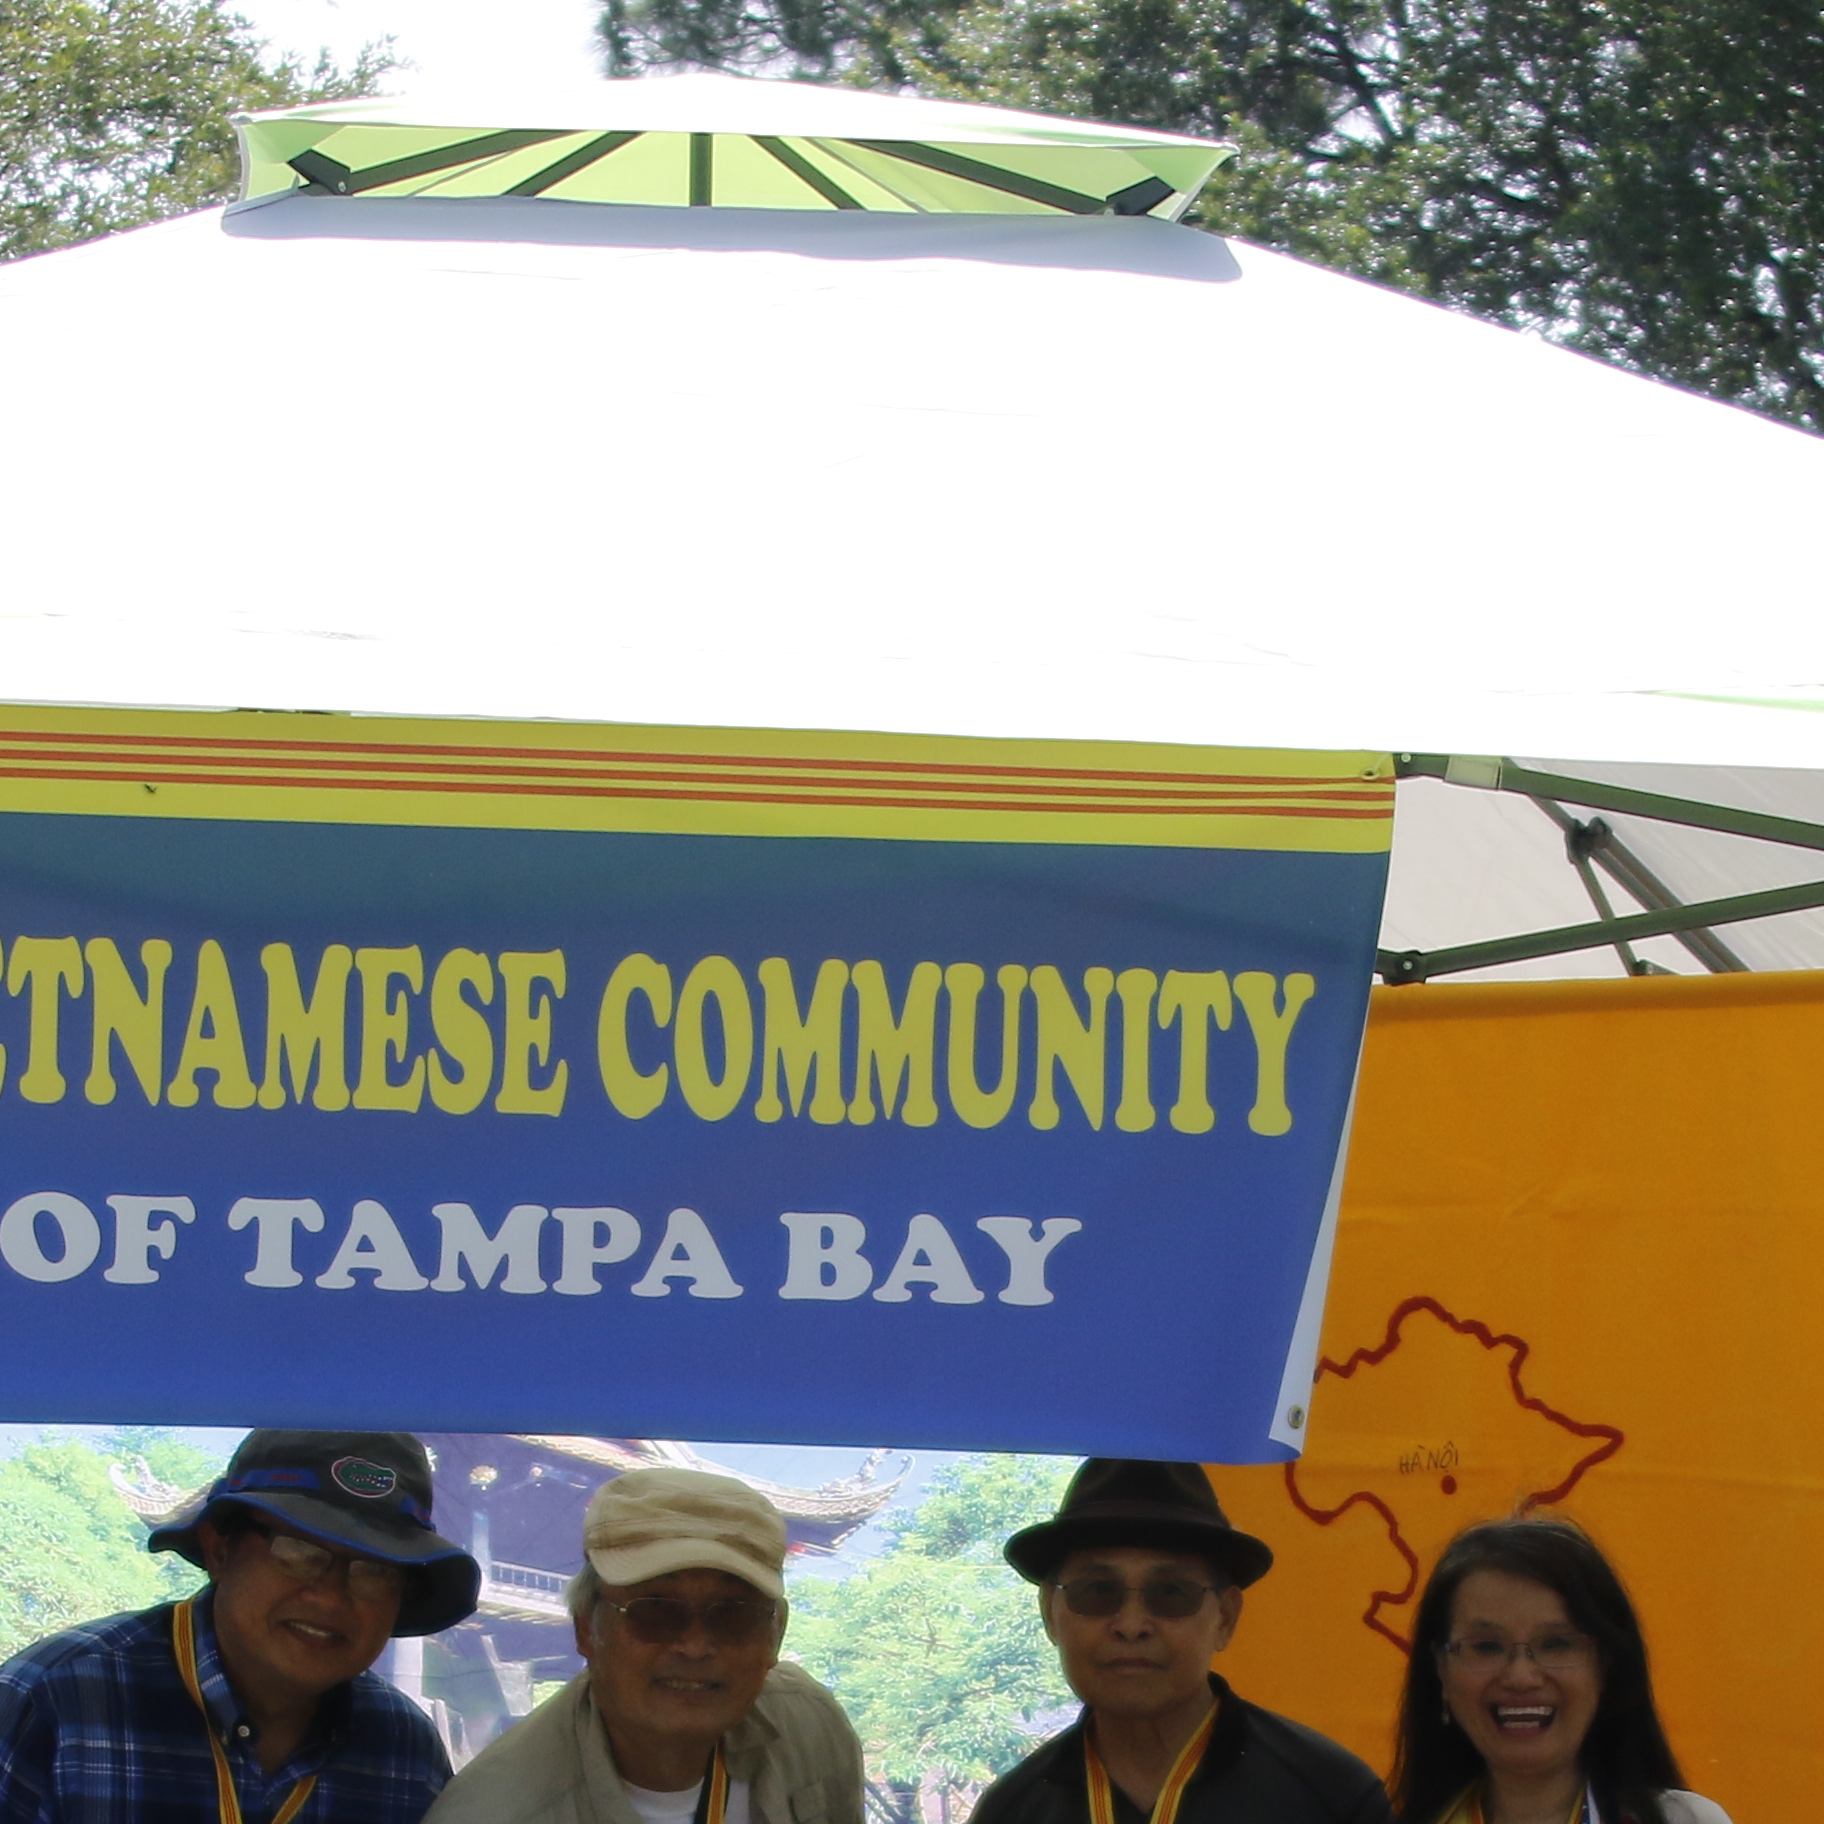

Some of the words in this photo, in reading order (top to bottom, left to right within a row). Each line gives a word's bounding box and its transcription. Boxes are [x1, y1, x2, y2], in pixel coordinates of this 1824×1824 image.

[597, 952, 1315, 1136] COMMUNITY
[227, 1196, 744, 1299] TAMPA
[777, 1212, 1083, 1306] BAY
